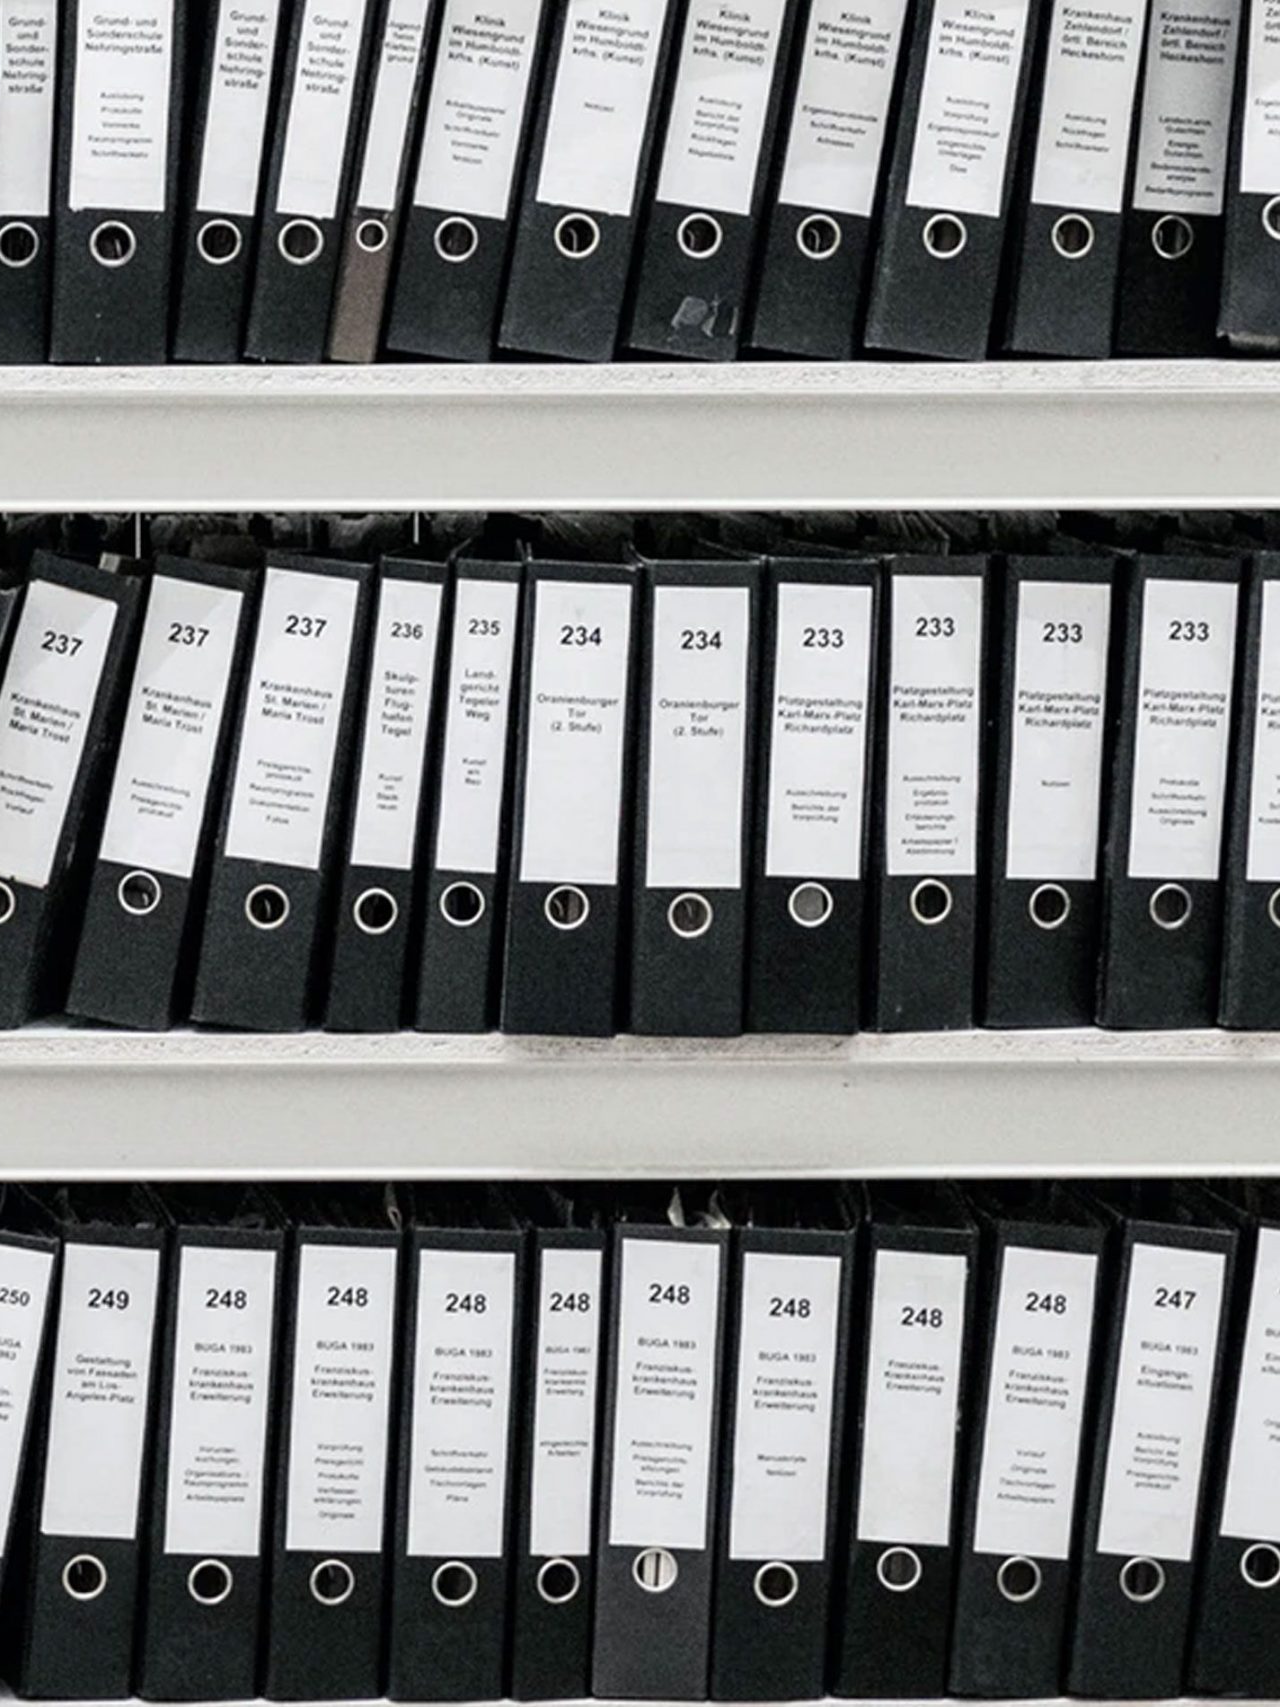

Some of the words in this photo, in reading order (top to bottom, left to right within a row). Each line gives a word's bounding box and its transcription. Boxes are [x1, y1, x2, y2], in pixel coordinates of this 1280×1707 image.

[92, 14, 133, 28] Grund-
[135, 17, 158, 29] und
[963, 8, 996, 22] Klinik
[1159, 10, 1232, 27] Krankenhaus
[85, 27, 165, 42] Sonderschule
[940, 18, 1016, 40] Wiesengrund
[968, 49, 1011, 66] (Kunst)
[167, 622, 210, 647] 237
[284, 614, 328, 638] 237
[391, 621, 423, 640] 236
[468, 618, 501, 636] 235
[915, 616, 956, 638] 233
[1042, 622, 1083, 644] 233
[1168, 620, 1210, 642] 233
[41, 630, 84, 657] 237
[560, 624, 602, 647] 234
[681, 629, 722, 651] 234
[802, 627, 845, 649] 233
[383, 669, 421, 686] Skulp-
[140, 685, 213, 710] Krankenhaus
[892, 684, 975, 699] Platzgestaltung
[1018, 689, 1102, 705] Platzgestaltung
[1142, 687, 1227, 704] Platzgestaltung
[535, 692, 620, 709] Oranienburger
[657, 697, 741, 713] Oranienburger
[777, 694, 864, 712] Platzgestaltung
[892, 698, 973, 710] Karl-Marx-Platz
[1142, 701, 1226, 716] Karl-Marx-Platz
[380, 710, 414, 724] hafen
[567, 706, 587, 719] Tor
[689, 711, 710, 724] Tor
[777, 707, 863, 723] Karl-Marx-Platz
[899, 711, 967, 725] Richardplatz
[1017, 703, 1100, 716] Karl-Marx-Platz
[141, 712, 173, 729] Maria
[567, 720, 603, 735] Stufe)
[783, 721, 855, 736] Richardplatz
[1024, 716, 1093, 731] Richardplatz
[1148, 714, 1218, 730] Richardplatz
[381, 723, 413, 739] Tegel
[690, 725, 725, 738] Stufe)
[87, 1288, 130, 1311] 249
[205, 1288, 248, 1310] 248
[327, 1285, 369, 1308] 248
[549, 1292, 591, 1313] 248
[648, 1283, 691, 1305] 248
[1154, 1287, 1197, 1310] 247
[445, 1292, 487, 1314] 248
[769, 1297, 811, 1319] 248
[1025, 1291, 1067, 1315] 248
[901, 1306, 943, 1329] 248
[193, 1341, 227, 1354] BUGA
[1140, 1340, 1173, 1353] BUGA
[74, 1353, 132, 1370] Gestaltung
[66, 1367, 87, 1376] von
[87, 1366, 139, 1380] Fassaden
[188, 1378, 255, 1392] krankenhaus
[64, 1389, 136, 1405] Angeles-Platz
[189, 1390, 253, 1406] Erweiterung
